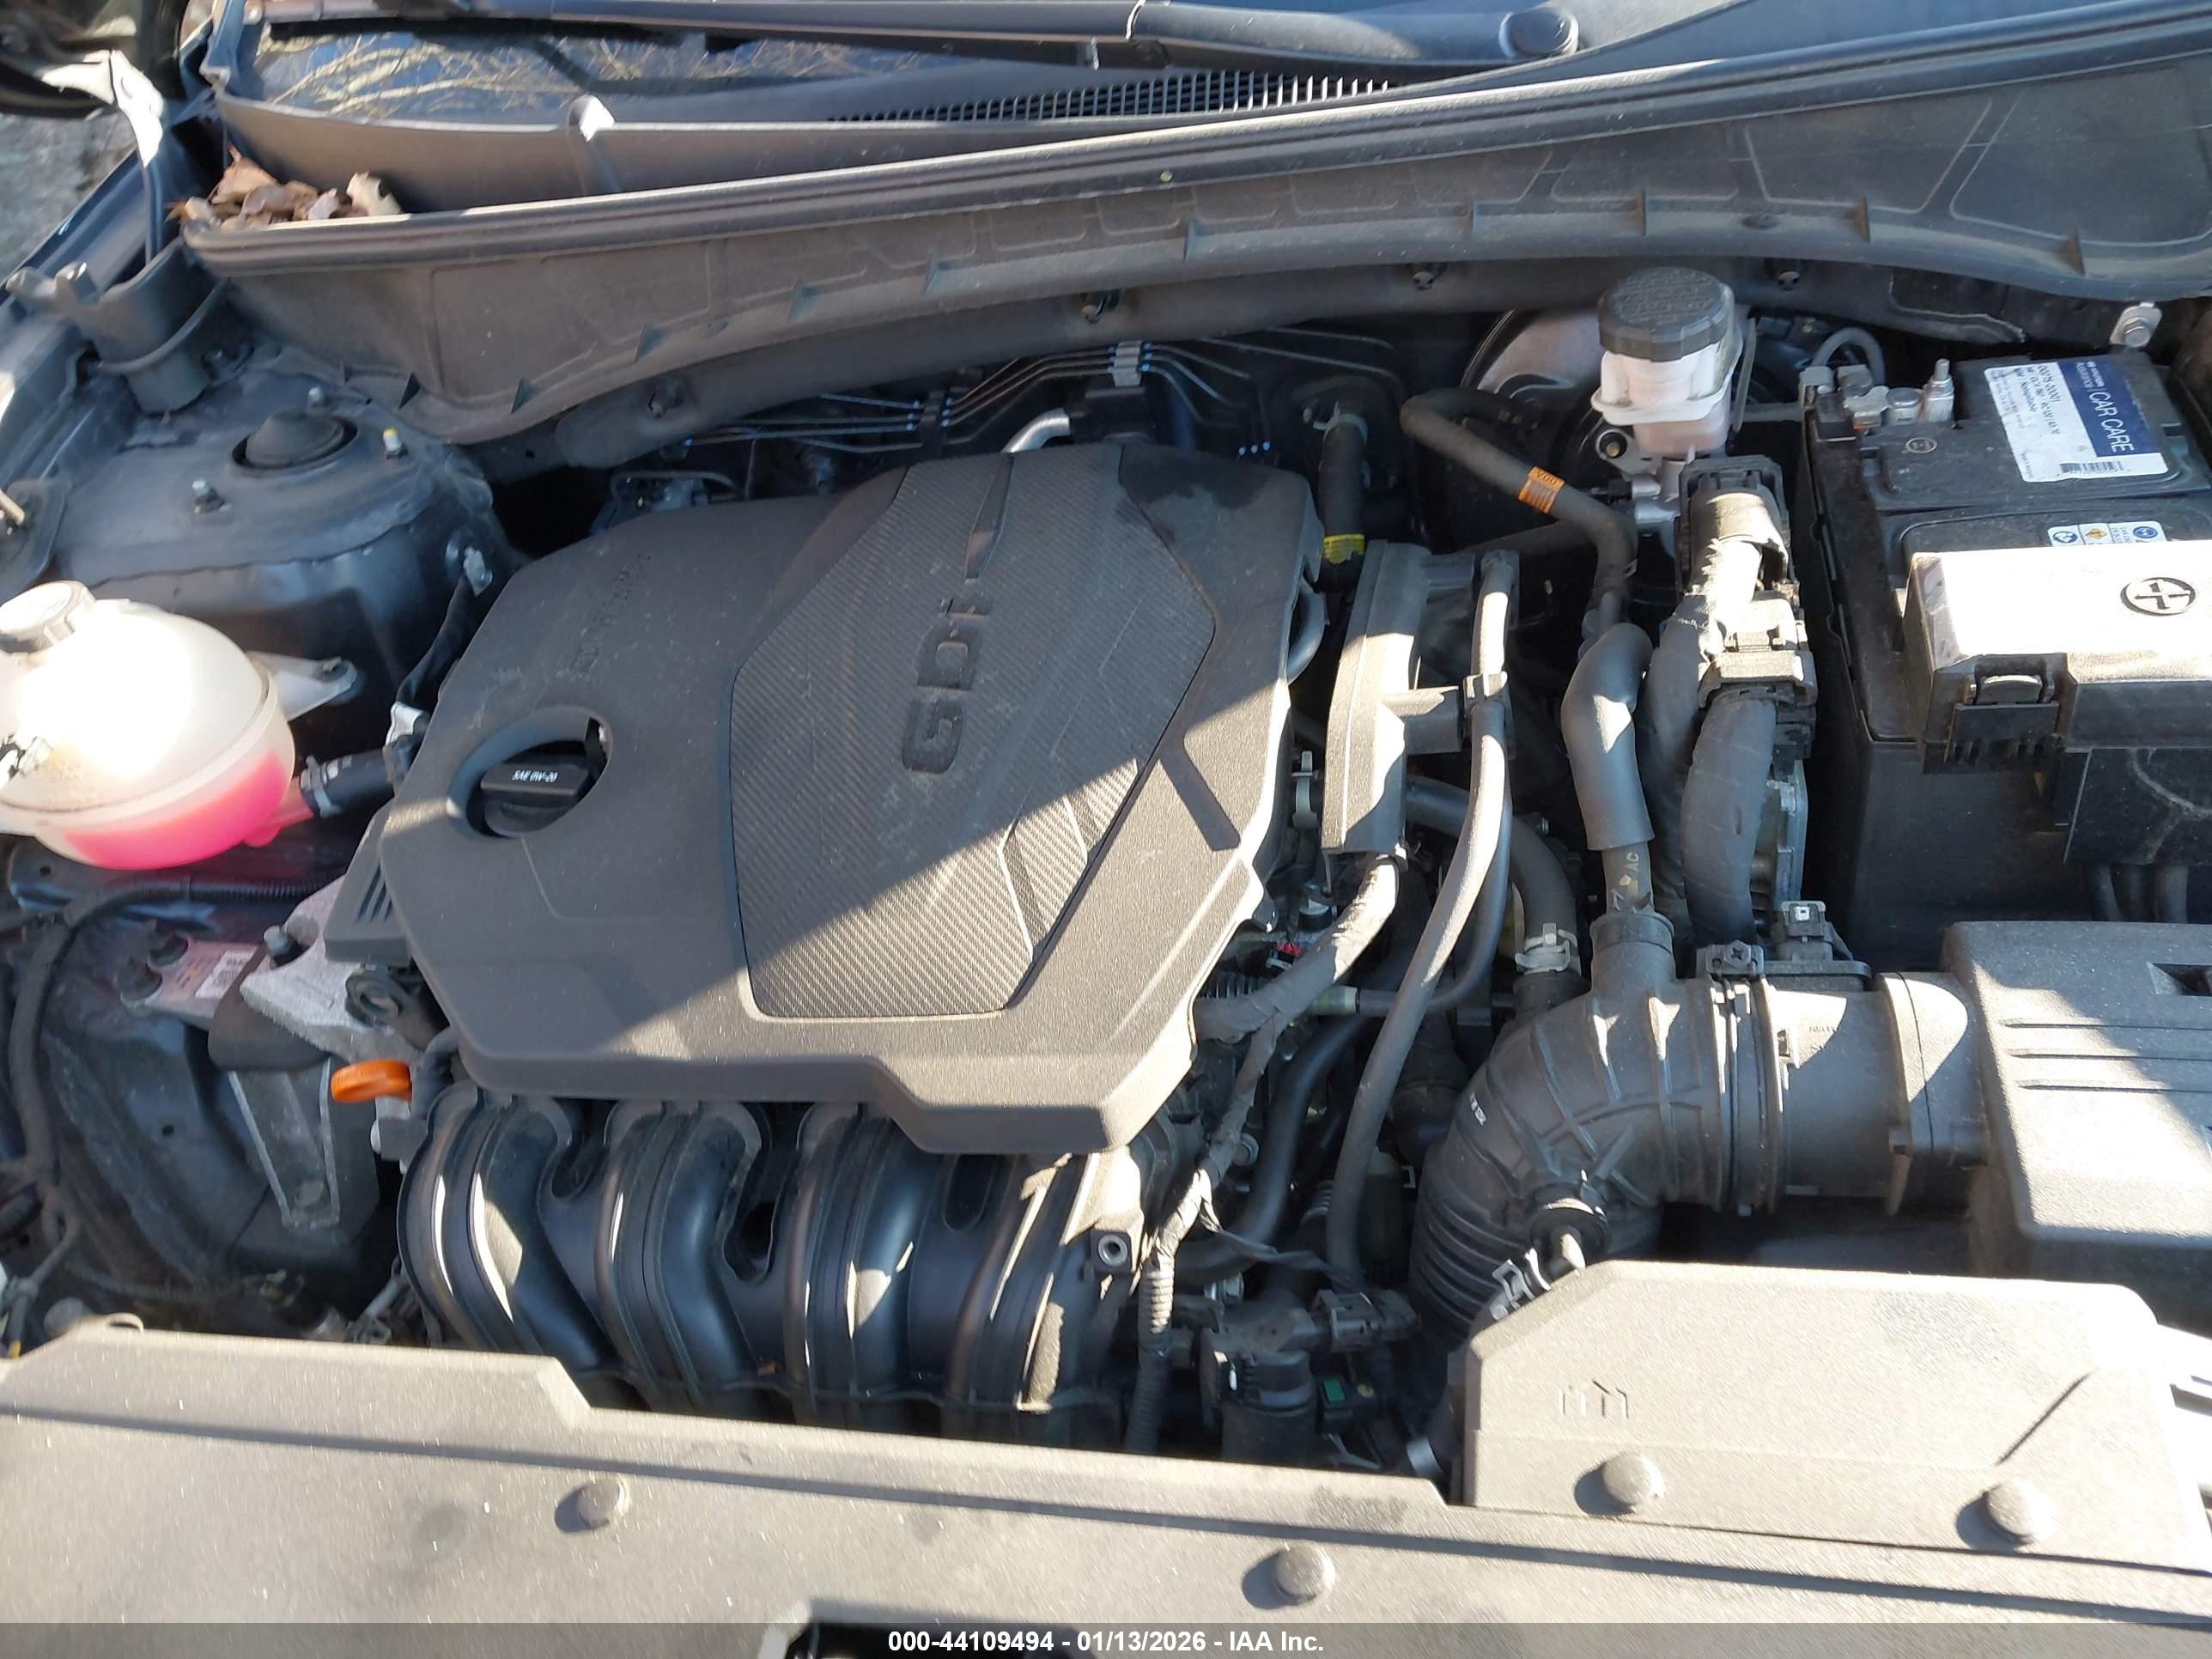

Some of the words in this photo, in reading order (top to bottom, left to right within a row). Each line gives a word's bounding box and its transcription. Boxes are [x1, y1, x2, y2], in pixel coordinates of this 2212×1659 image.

[2088, 392, 2118, 417] CAR
[2101, 418, 2135, 453] CARE
[512, 769, 532, 781] SAE
